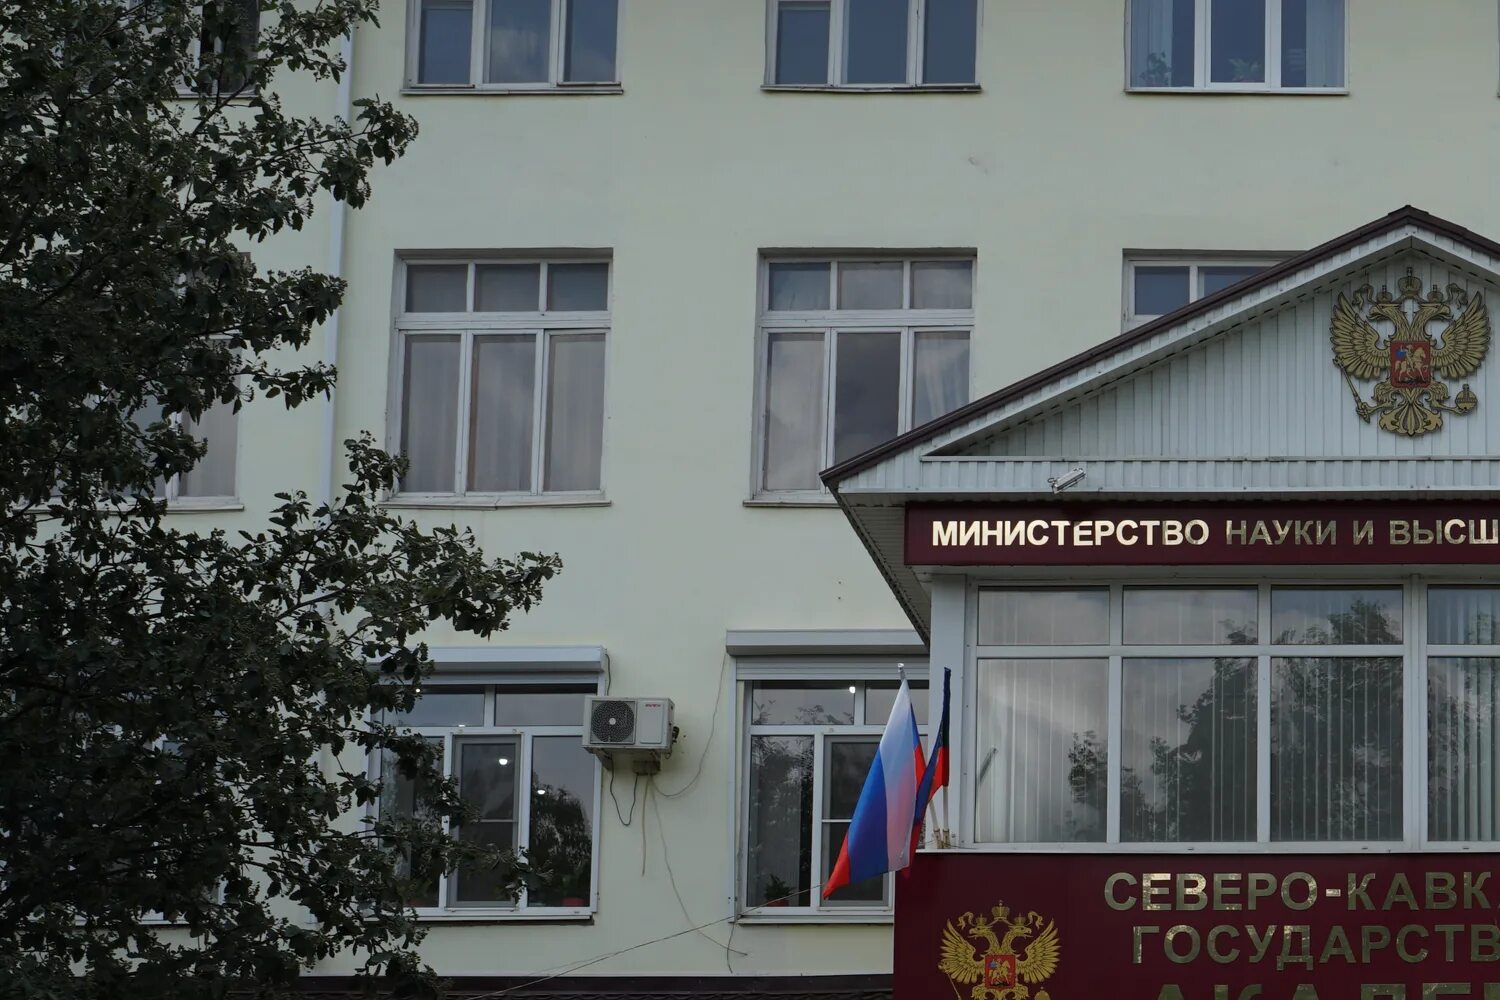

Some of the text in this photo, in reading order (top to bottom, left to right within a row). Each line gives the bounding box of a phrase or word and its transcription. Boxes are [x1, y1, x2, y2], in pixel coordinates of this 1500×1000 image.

[932, 519, 1210, 546] МИНИСТЕРСТВО
[1225, 519, 1337, 546] НАУКИ
[1352, 520, 1374, 545] И
